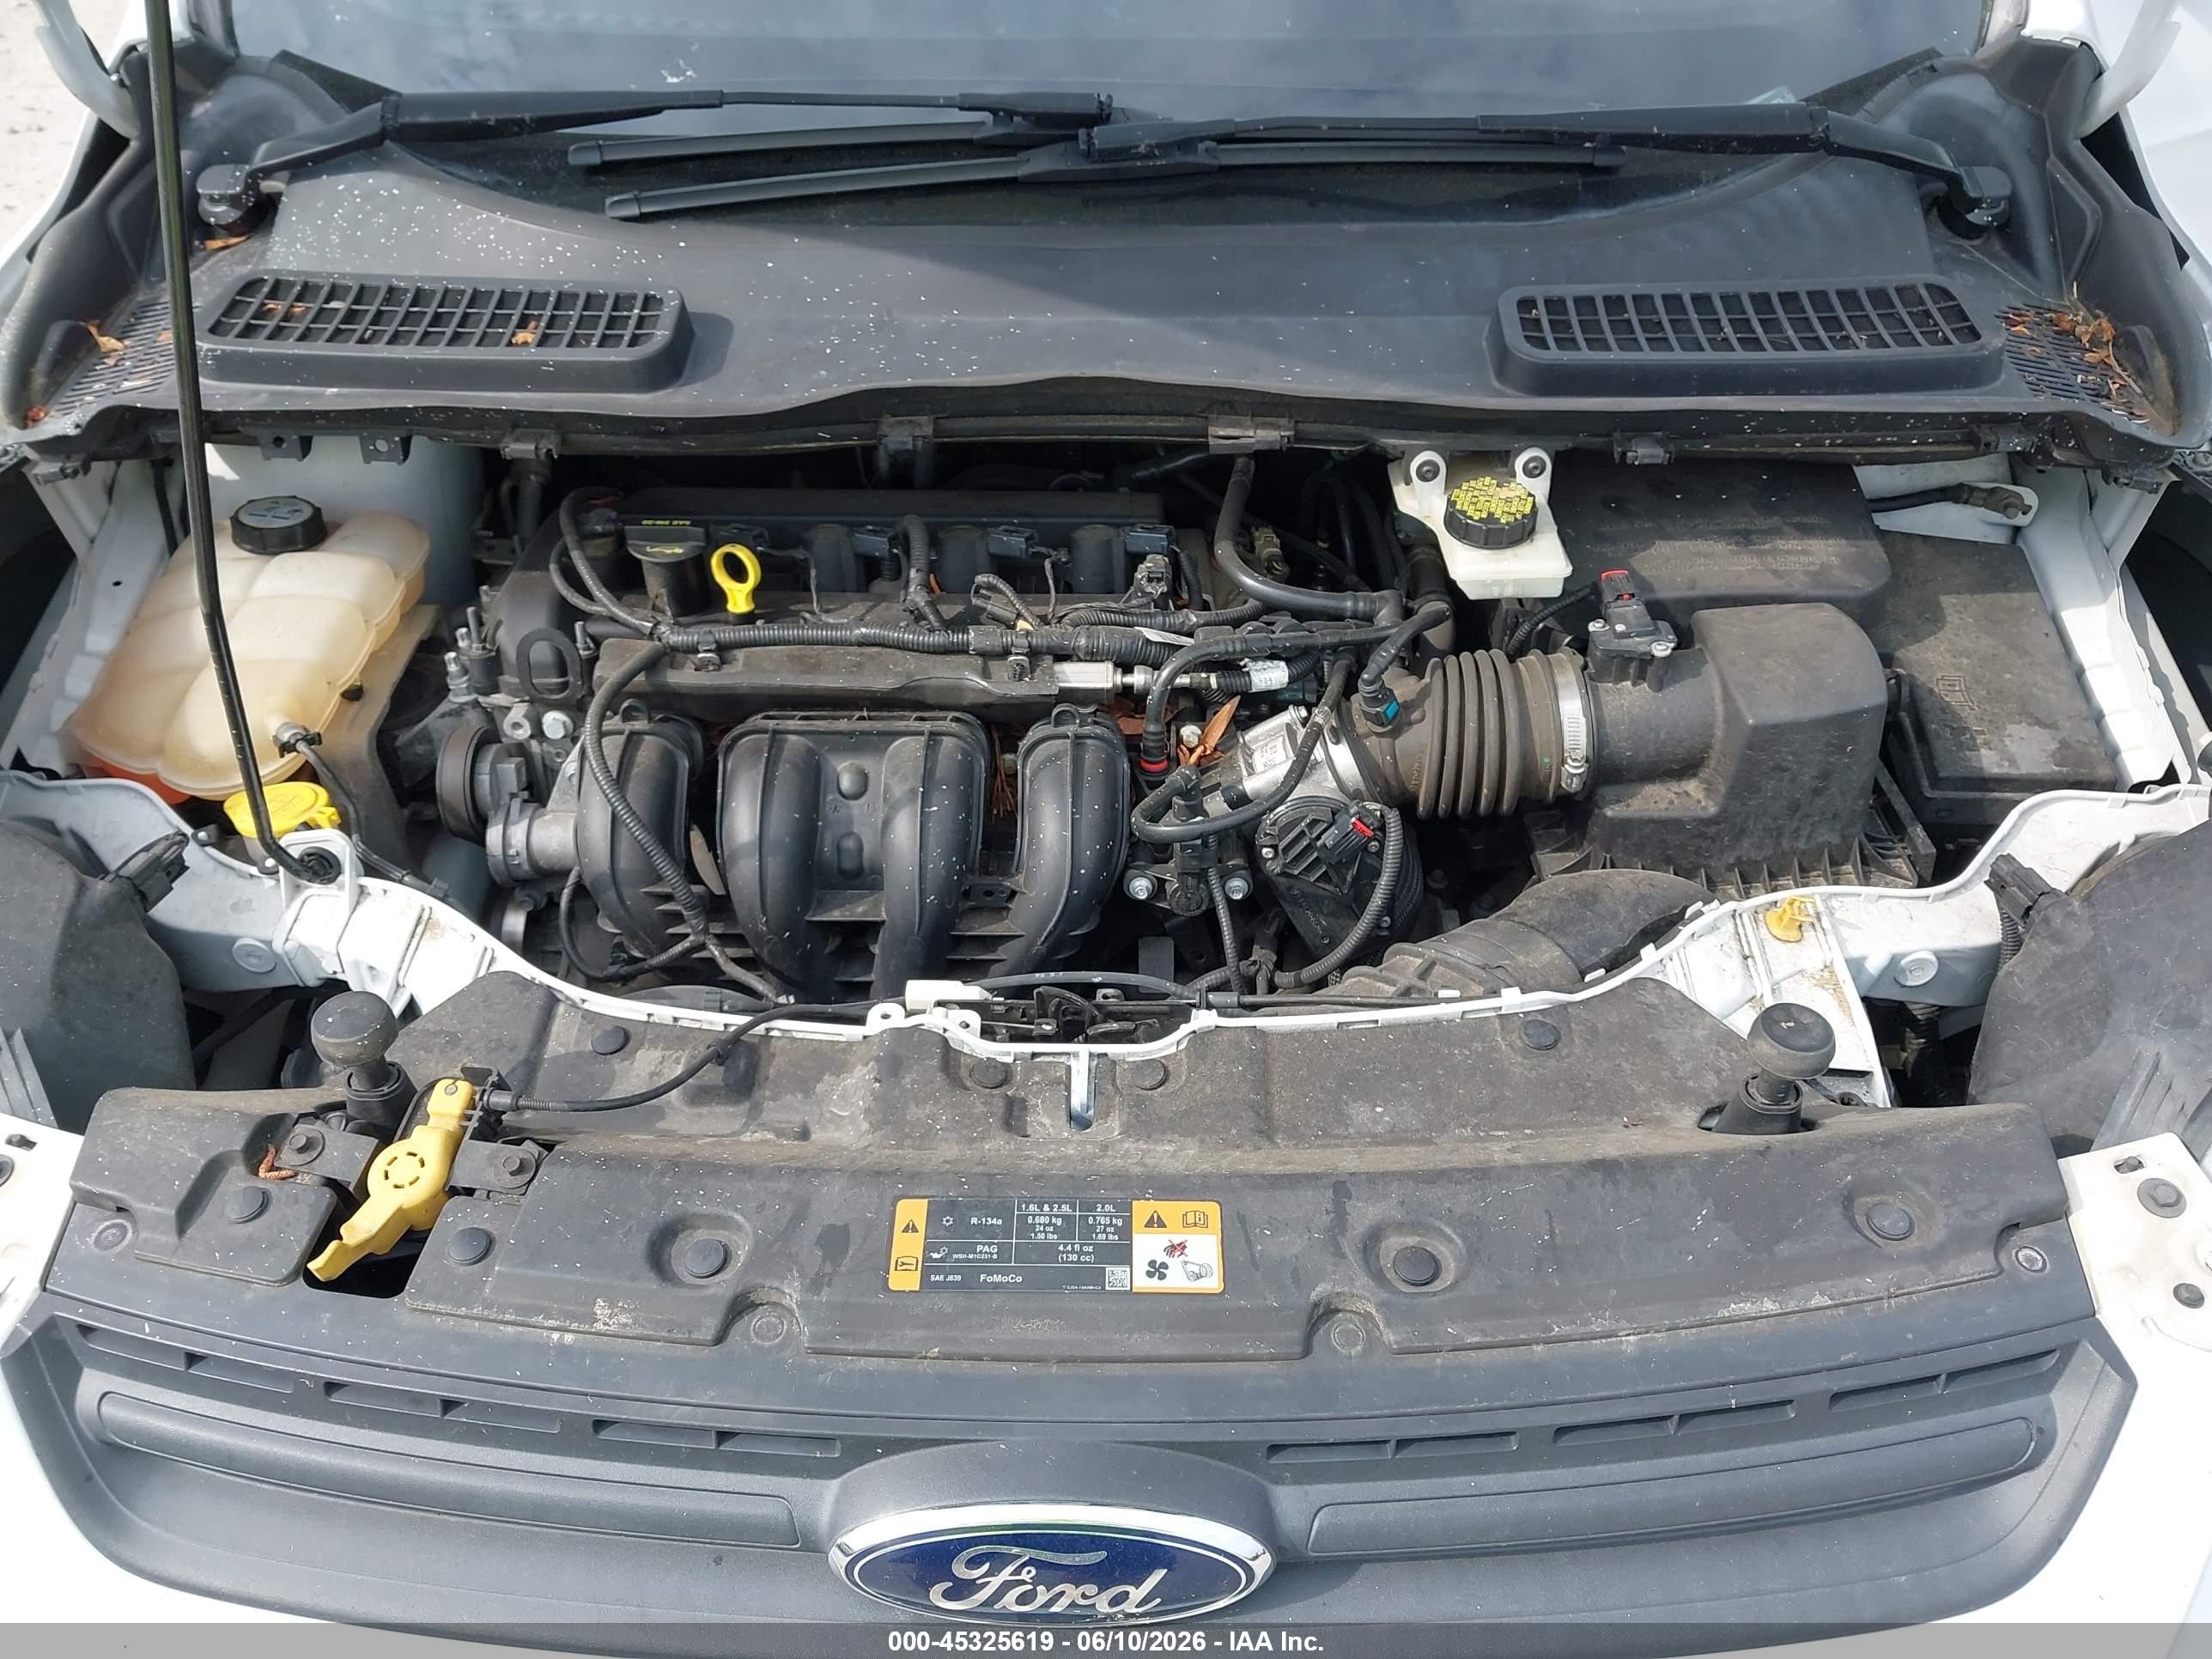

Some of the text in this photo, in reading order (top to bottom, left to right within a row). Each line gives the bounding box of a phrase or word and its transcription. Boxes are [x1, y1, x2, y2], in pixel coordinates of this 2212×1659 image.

[1053, 1204, 1073, 1212] 2.5L
[1052, 1216, 1062, 1226] kg
[1112, 1217, 1123, 1226] kg
[1058, 1254, 1095, 1263] (130 cc)
[980, 1274, 1023, 1283] FoMoCo
[929, 1545, 1169, 1613] Ford
